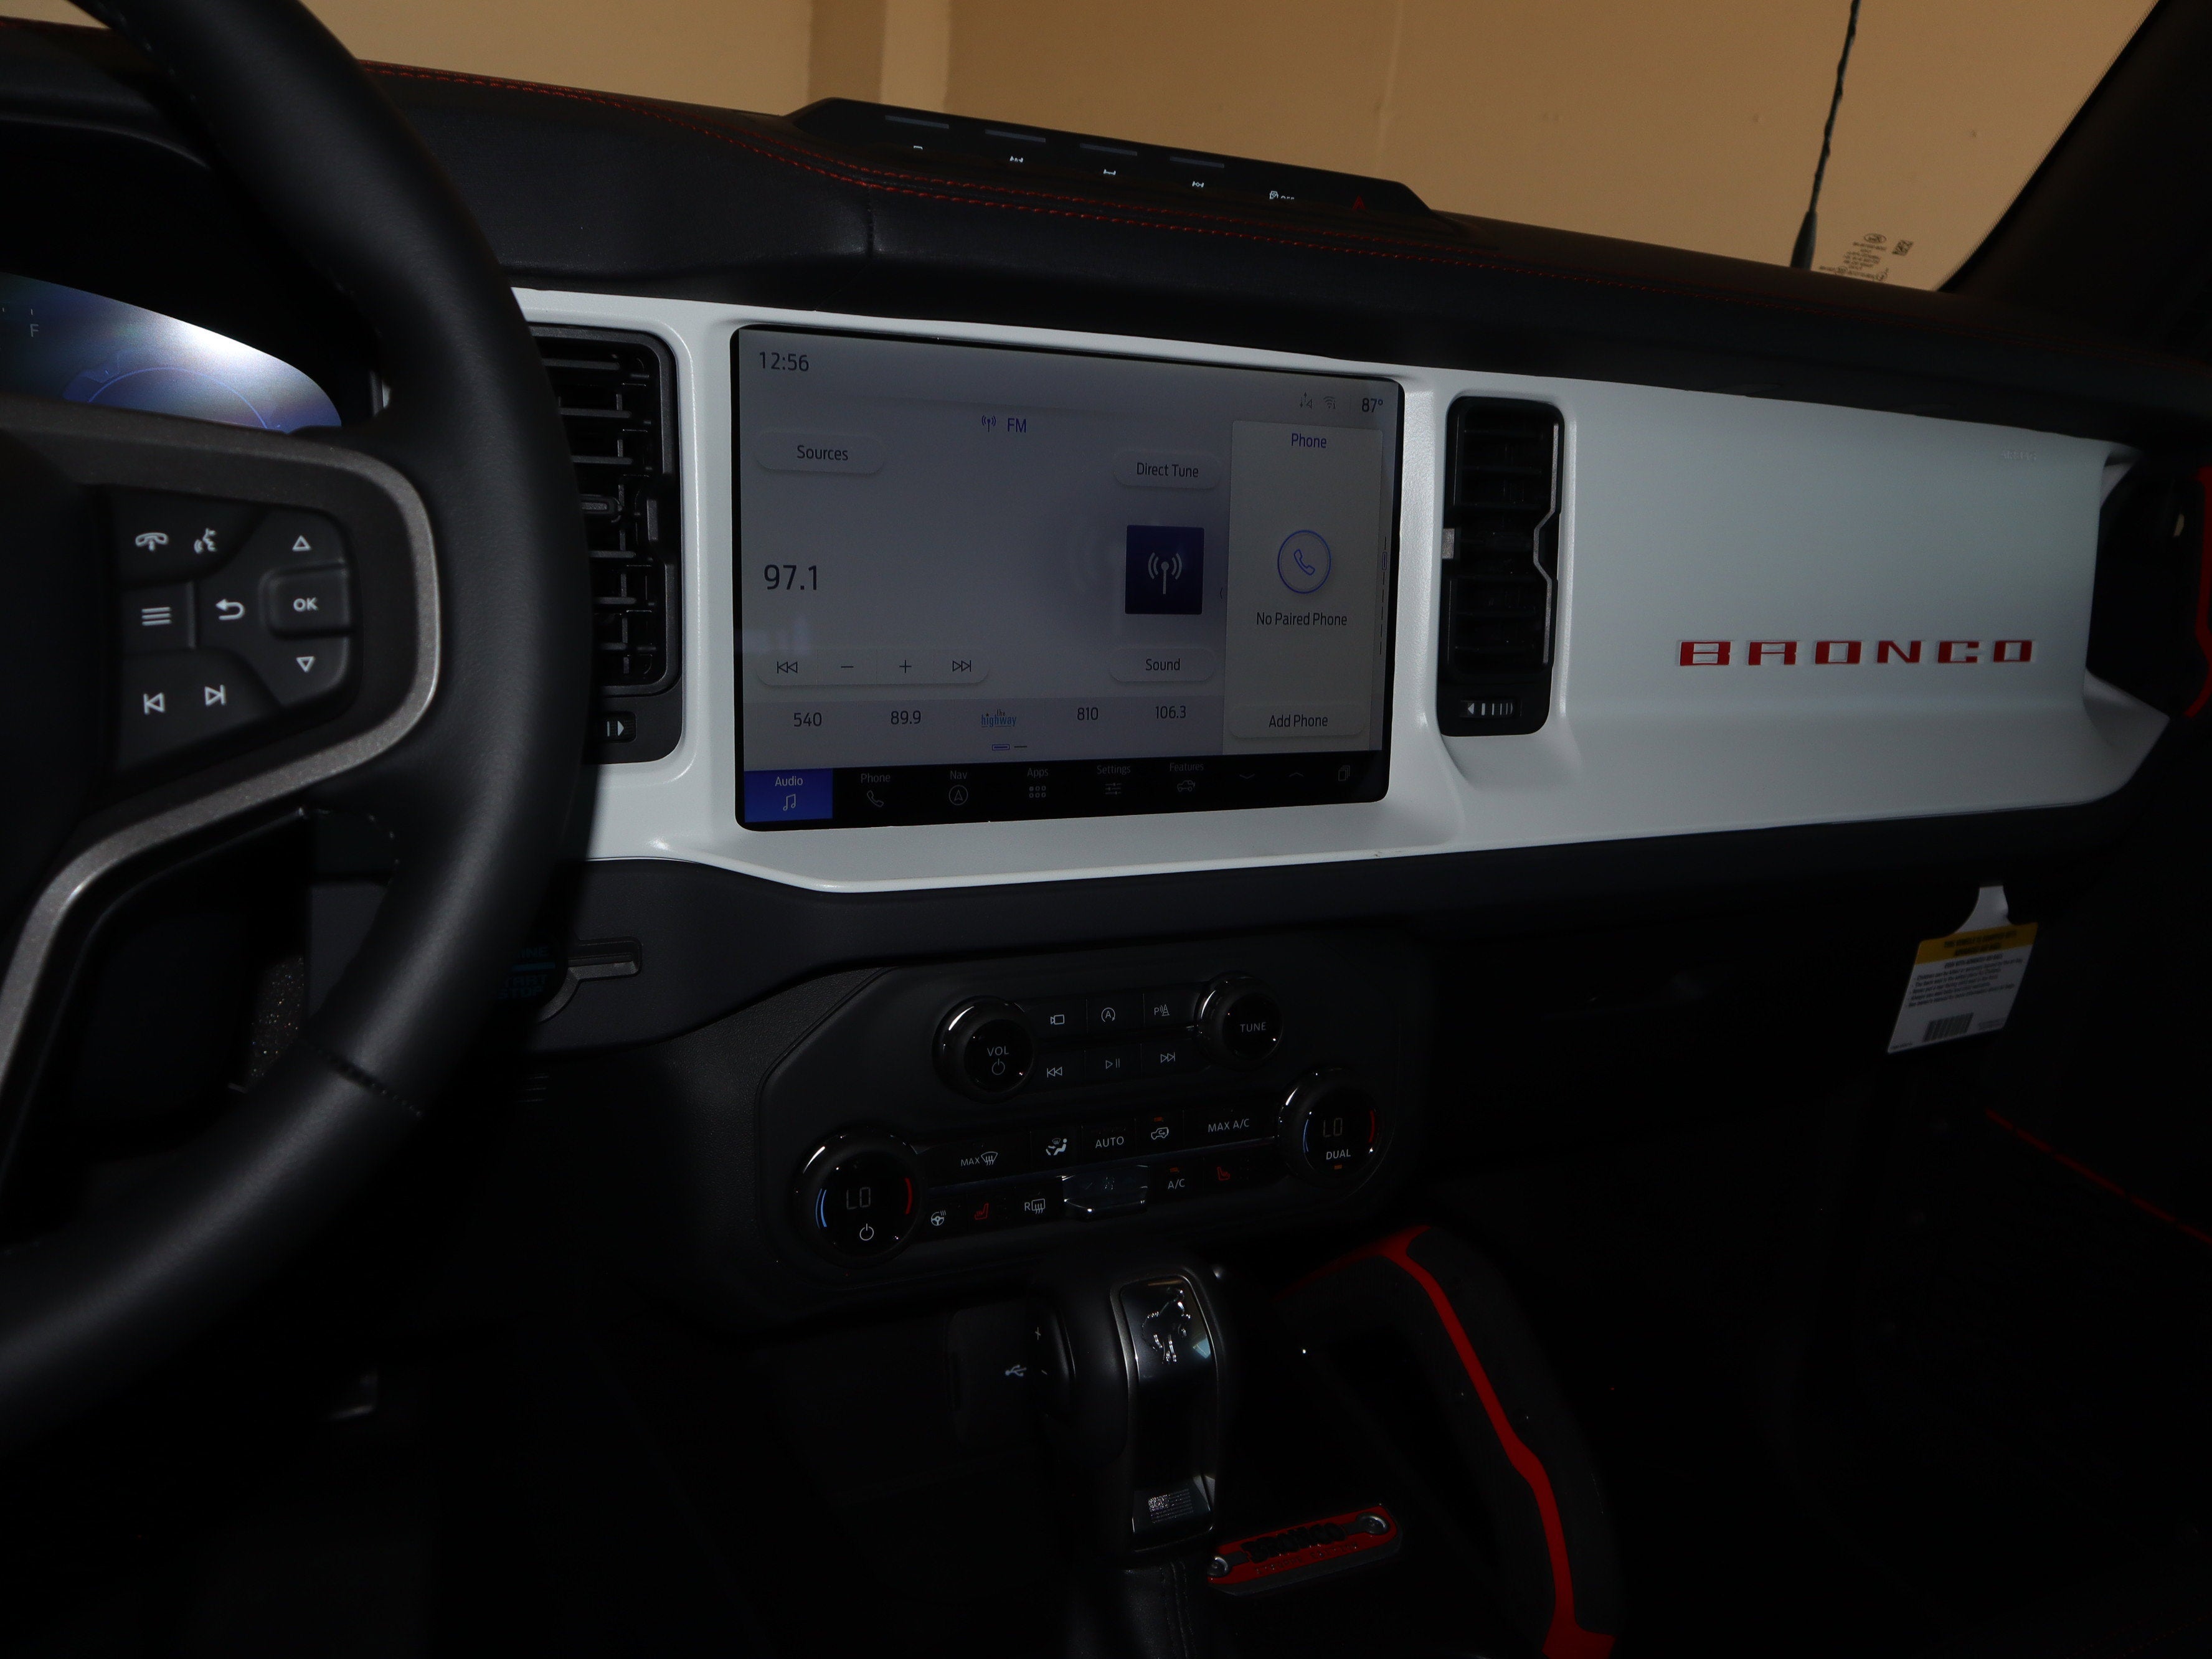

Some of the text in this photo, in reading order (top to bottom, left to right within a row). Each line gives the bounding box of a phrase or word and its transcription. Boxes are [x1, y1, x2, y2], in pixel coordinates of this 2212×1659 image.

[30, 323, 39, 338] F
[759, 352, 810, 372] 12:56
[1006, 418, 1027, 433] FM
[1291, 433, 1327, 449] Phone
[796, 445, 849, 462] Sources
[1137, 462, 1199, 478] Direct Tune
[763, 564, 818, 591] 97.1
[293, 597, 318, 612] OK
[1256, 612, 1348, 626] No Paired Phone
[1679, 640, 2033, 666] BRONCO
[1145, 658, 1181, 671] Sound
[793, 712, 822, 727] 540
[891, 711, 922, 725] 89.9
[1077, 707, 1099, 721] 810
[1155, 706, 1186, 719] 106.3
[981, 714, 1017, 728] highway
[1269, 715, 1328, 727] Add Phone
[1026, 767, 1049, 778] Apps
[1096, 764, 1131, 775] Settings
[1169, 761, 1204, 772] Features
[775, 775, 803, 787] Audio
[860, 773, 891, 784] Phone
[950, 771, 968, 780] Nav
[504, 975, 548, 987] TART
[1239, 1021, 1267, 1033] TUNE
[986, 1046, 1009, 1057] VOL
[1208, 1117, 1250, 1133] MAX A/C
[1095, 1135, 1125, 1149] AUTO
[960, 1156, 980, 1167] MAX
[1325, 1148, 1352, 1161] DUAL
[1167, 1178, 1186, 1190] A/C
